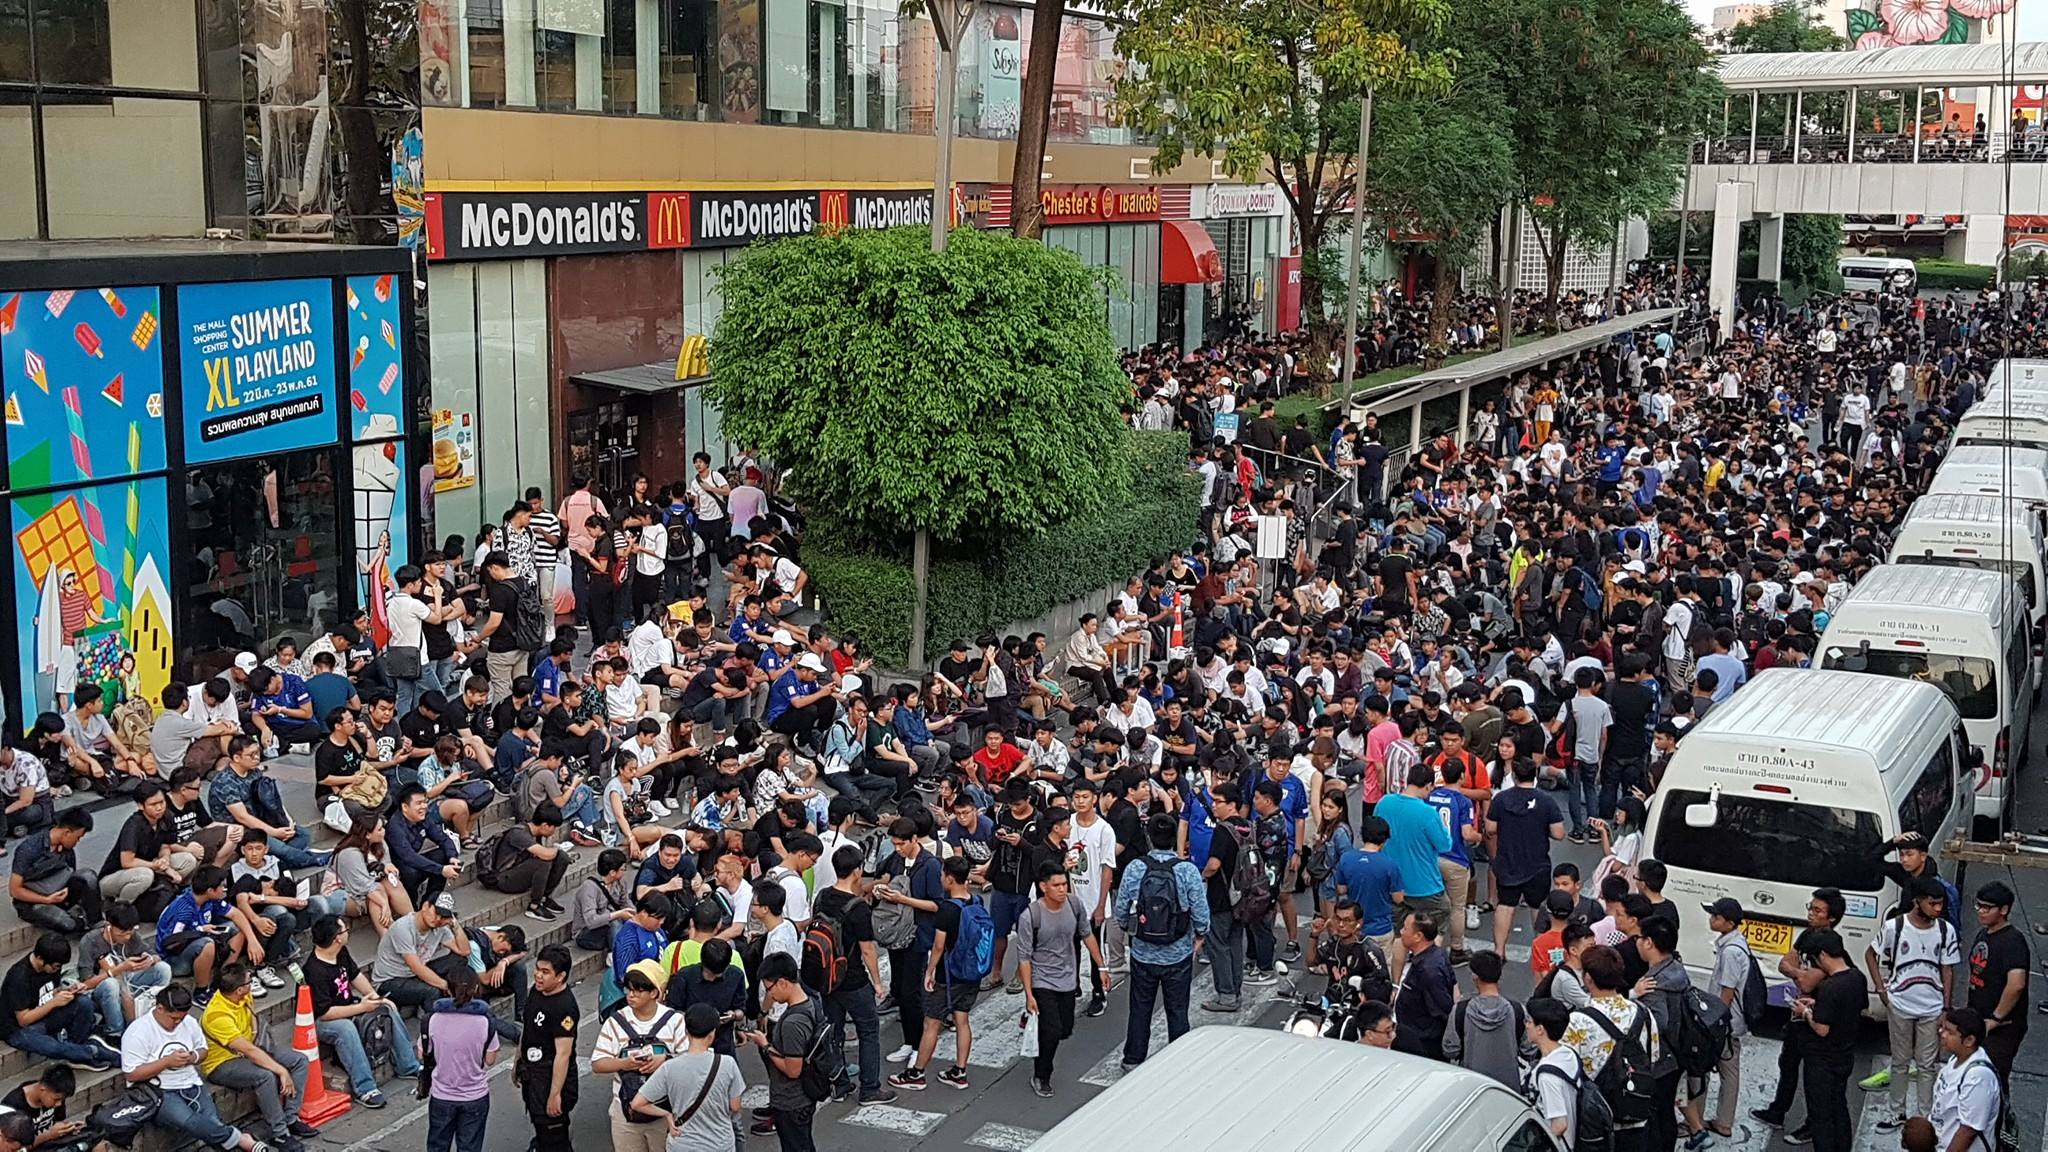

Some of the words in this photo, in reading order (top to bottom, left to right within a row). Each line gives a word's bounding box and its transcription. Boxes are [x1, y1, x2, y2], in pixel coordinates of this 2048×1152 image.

[855, 195, 931, 230] McDonald's
[1043, 191, 1097, 215] Chester's
[1249, 193, 1275, 208] DONUTS
[461, 201, 636, 248] McDonald's
[701, 199, 812, 239] McDonald's
[193, 323, 207, 333] THE
[208, 319, 227, 330] MALL
[230, 301, 312, 349] SUMMER
[193, 331, 228, 345] SHOPPING
[202, 341, 229, 354] CENTER
[203, 357, 239, 412] XL
[235, 340, 316, 385] PLAYLAND
[112, 1104, 146, 1119] adidas
